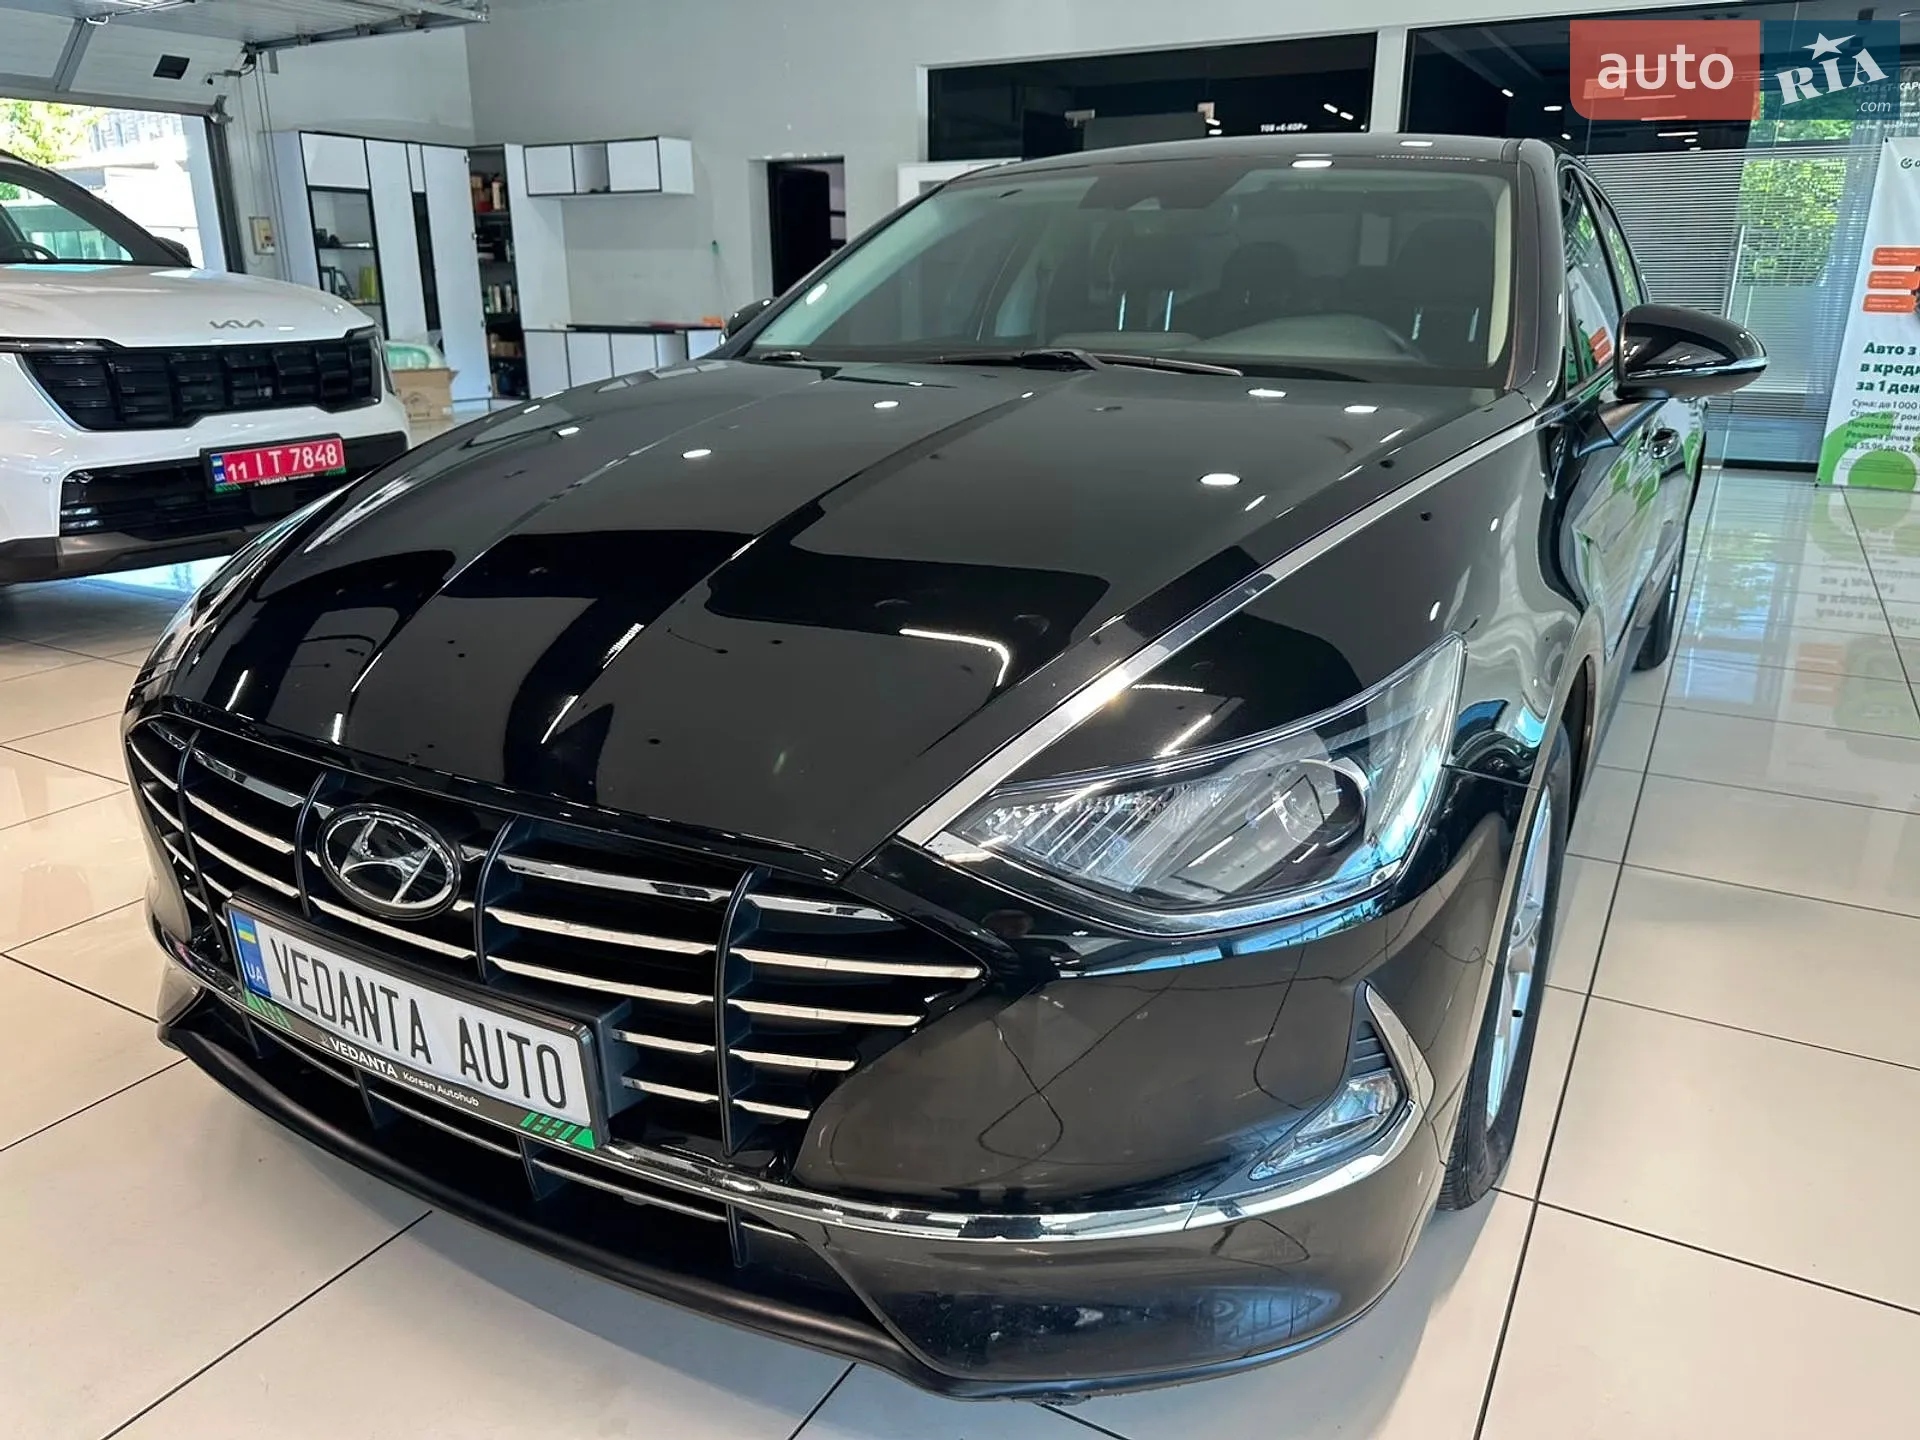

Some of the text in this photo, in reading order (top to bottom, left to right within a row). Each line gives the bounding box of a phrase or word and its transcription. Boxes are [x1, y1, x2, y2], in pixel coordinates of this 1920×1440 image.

[1863, 342, 1905, 355] Авто
[1860, 363, 1870, 372] в
[1856, 381, 1874, 391] за
[1878, 380, 1886, 392] 1
[227, 443, 338, 481] 11 IT 7848
[245, 961, 265, 984] UA
[270, 937, 568, 1110] VEDANTA AUTO
[329, 1036, 480, 1107] VEDANTA Korean Autohub
